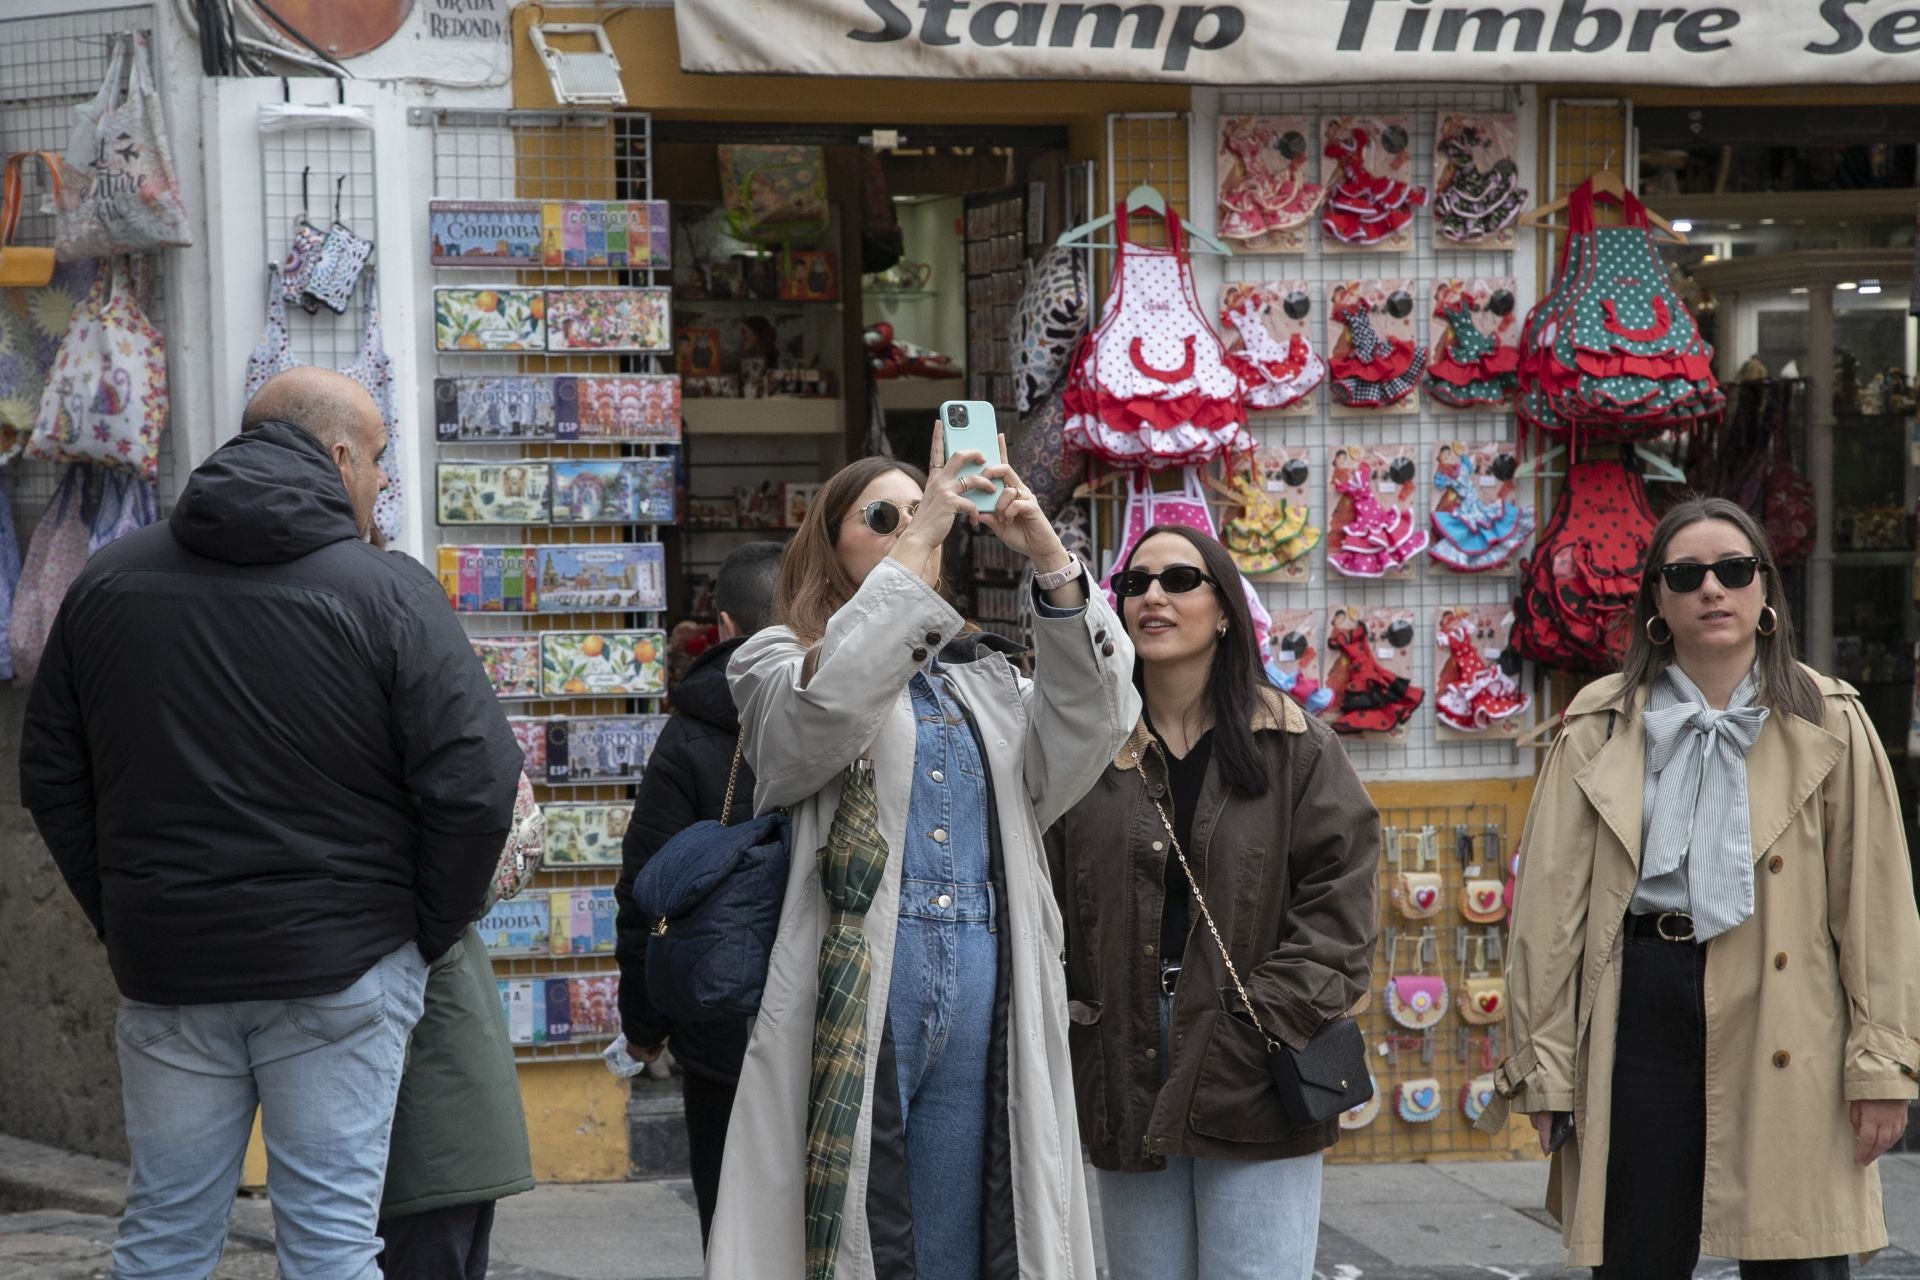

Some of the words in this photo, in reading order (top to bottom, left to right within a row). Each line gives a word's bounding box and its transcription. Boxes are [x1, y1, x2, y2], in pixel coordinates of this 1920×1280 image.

[1336, 0, 1741, 53] Timbre
[846, 0, 1244, 71] Stamp
[439, 423, 458, 433] ESP
[558, 422, 578, 433] ESP
[549, 765, 568, 776] ESP
[550, 1023, 570, 1035] ESP
